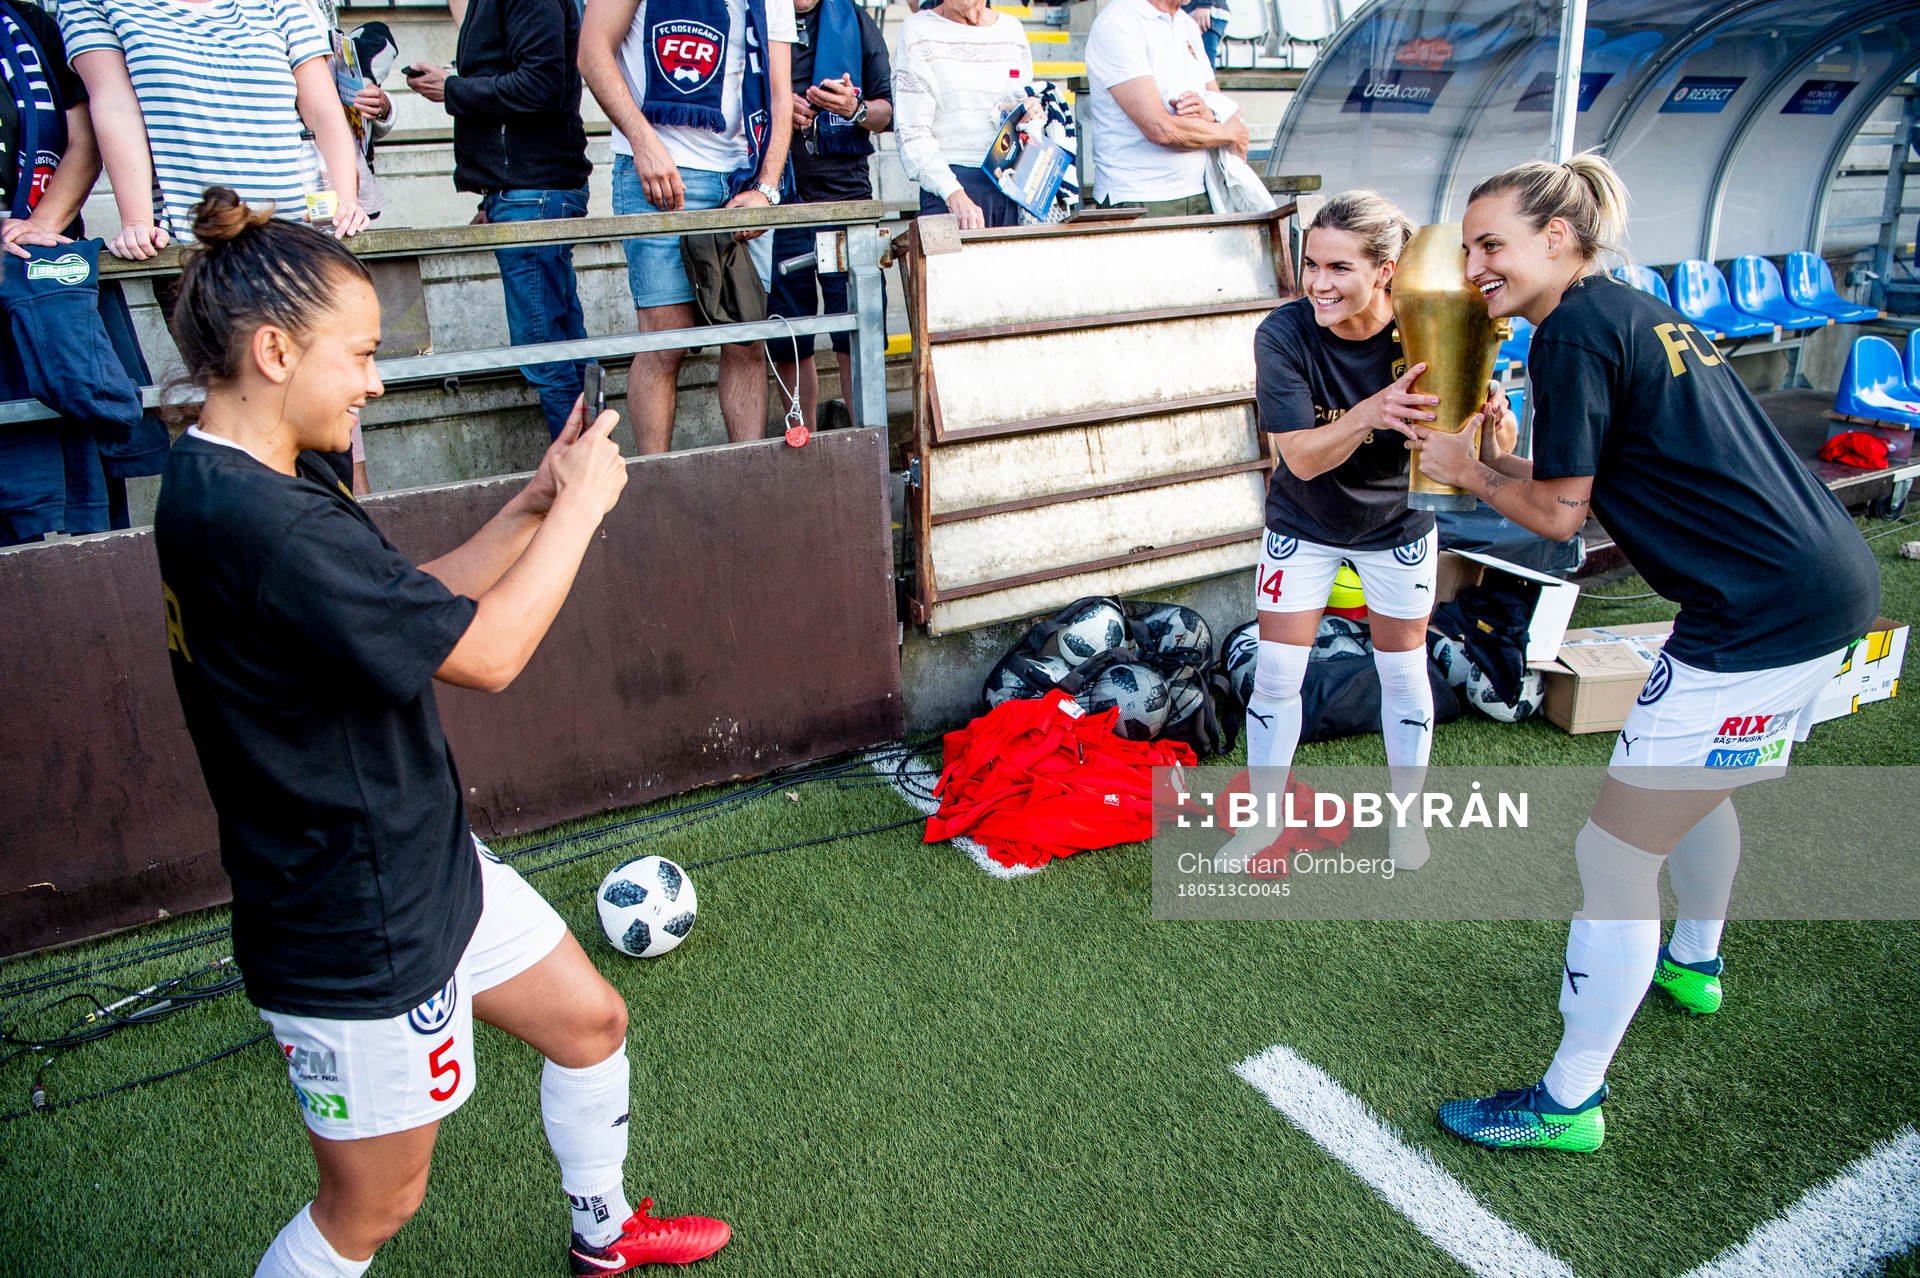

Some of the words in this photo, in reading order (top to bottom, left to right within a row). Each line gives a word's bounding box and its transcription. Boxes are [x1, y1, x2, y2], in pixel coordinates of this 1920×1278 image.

[671, 25, 719, 41] ROSENGÅRD
[662, 39, 714, 63] FCR
[1364, 83, 1431, 99] UEFA.com
[1686, 88, 1733, 100] RESPECT
[1653, 322, 1727, 378] FC
[1257, 563, 1284, 604] 14
[1713, 751, 1756, 767] MKB
[428, 1036, 461, 1102] 5
